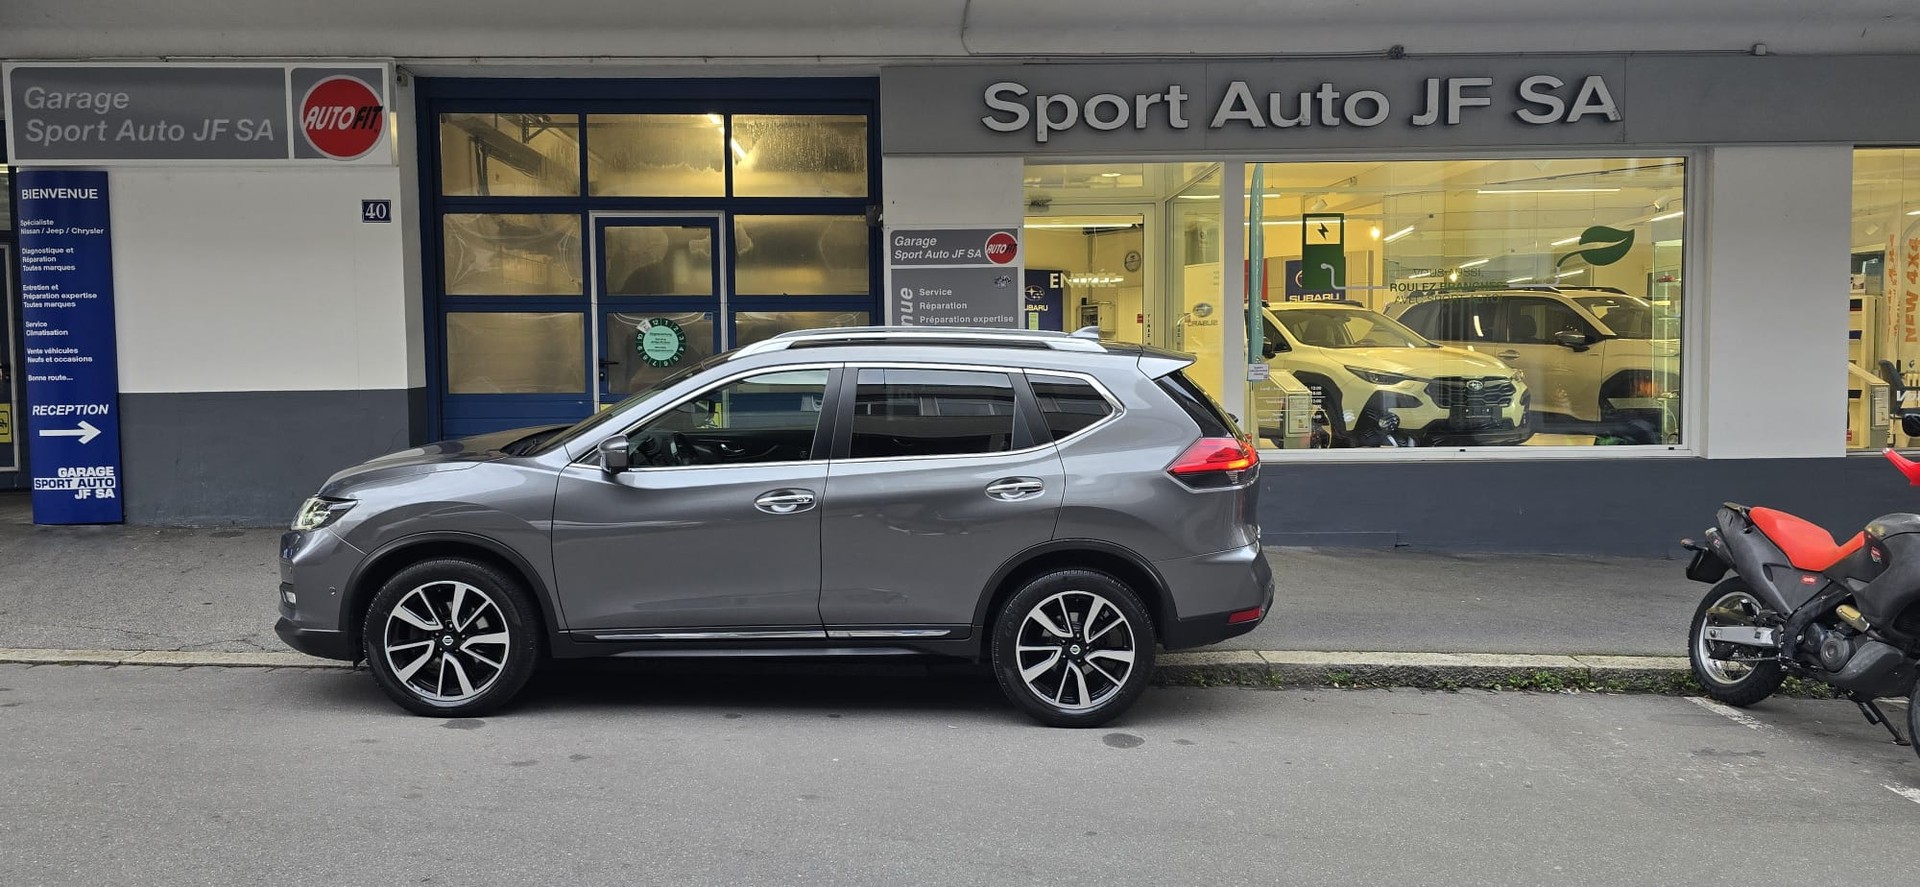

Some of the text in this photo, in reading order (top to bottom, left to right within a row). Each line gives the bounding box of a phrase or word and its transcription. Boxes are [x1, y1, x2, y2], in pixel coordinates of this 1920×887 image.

[24, 86, 130, 114] Garage
[981, 75, 1623, 142] Sport Auto JF SA
[304, 105, 383, 130] AUTOFIT
[25, 118, 275, 147] Sport Auto JF SA
[21, 188, 99, 200] BIENVENUE
[365, 203, 387, 219] 40
[20, 219, 54, 227] Spécialiste
[45, 228, 65, 236] Jeep
[71, 227, 104, 236] Chrysler
[894, 236, 937, 248] Garage
[894, 249, 982, 260] Sport Auto JF SA
[1050, 268, 1117, 288] ENTRÉE
[919, 288, 952, 296] Service
[1390, 283, 1436, 292] ROULEZ
[61, 292, 97, 300] expertise
[1289, 293, 1340, 303] SUBARU
[44, 301, 76, 309] marques
[919, 302, 968, 311] Réparation
[919, 315, 1014, 325] Préparation expertise
[1905, 291, 1919, 343] NEW
[53, 355, 93, 363] occasions
[32, 404, 109, 416] RECEPTION
[57, 466, 114, 478] GARAGE
[35, 478, 115, 489] SPORT AUTO
[74, 489, 115, 499] JF SA
